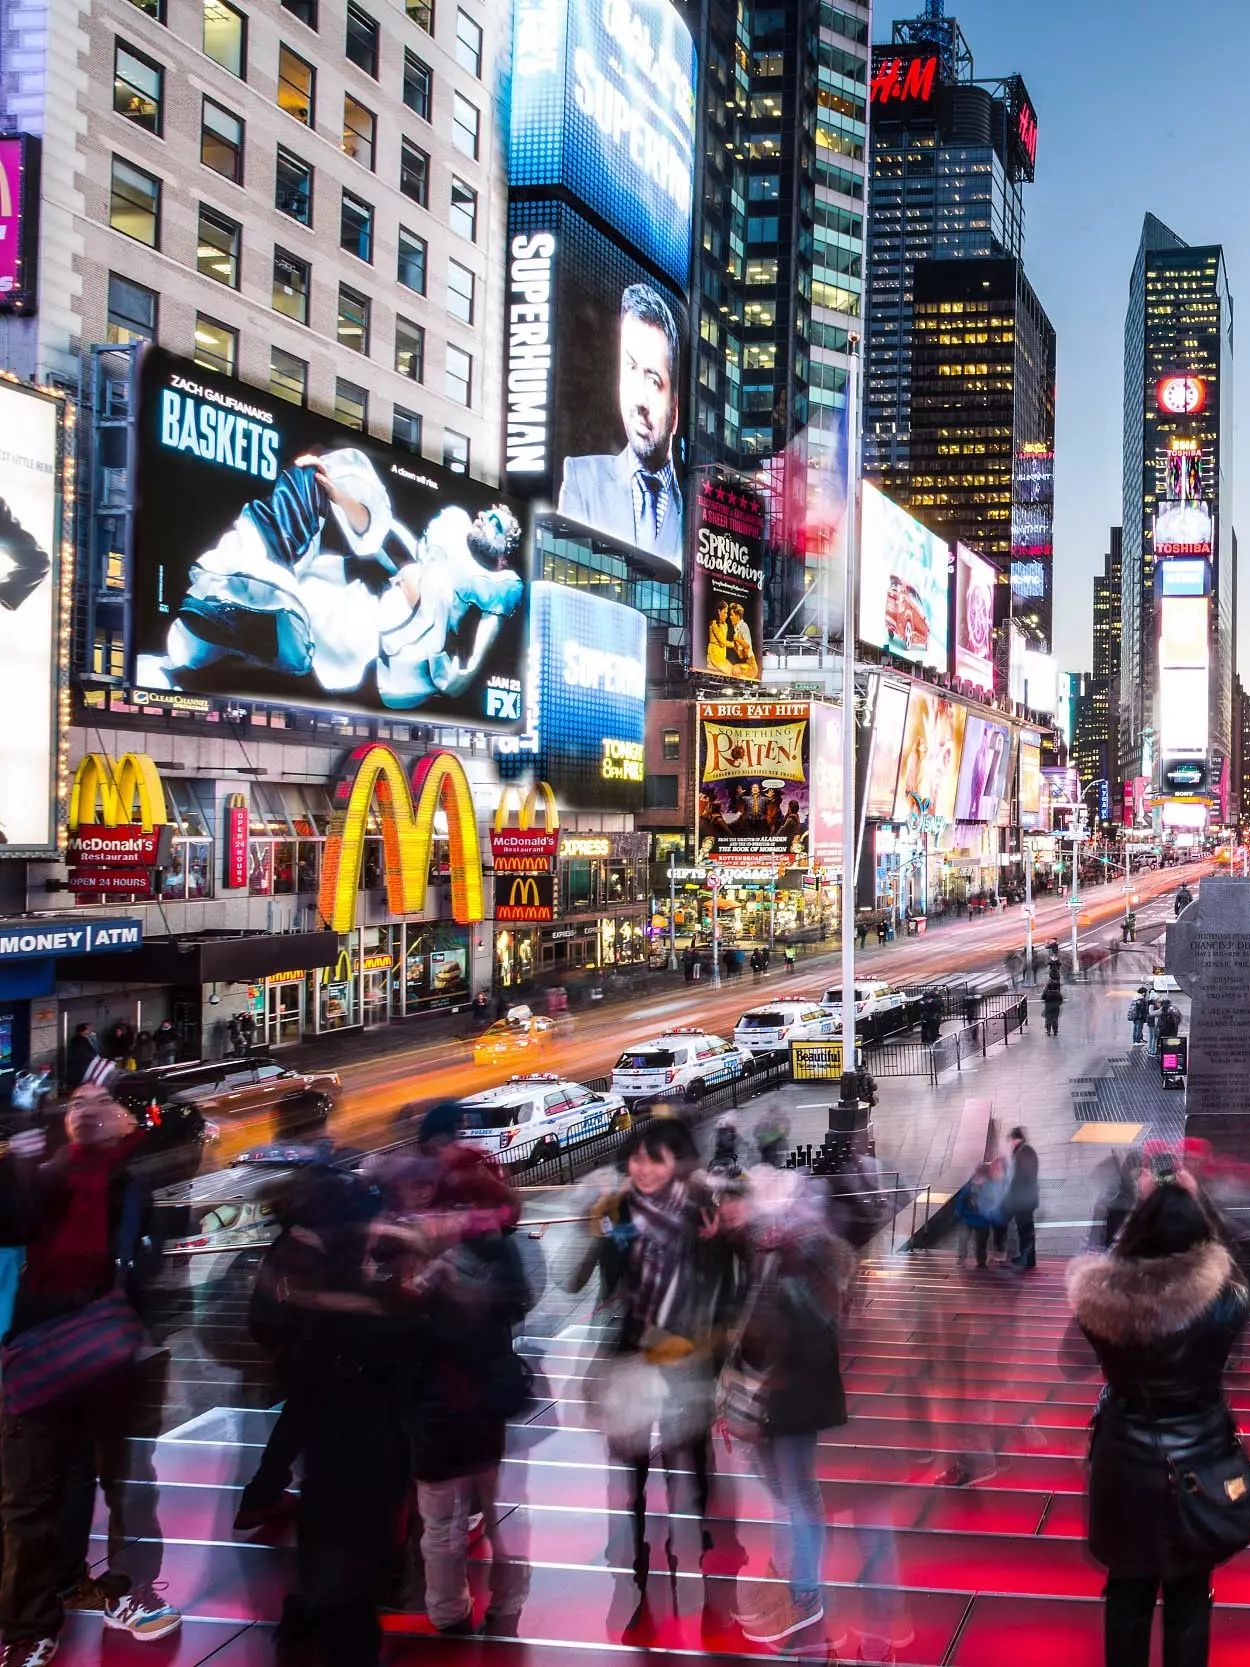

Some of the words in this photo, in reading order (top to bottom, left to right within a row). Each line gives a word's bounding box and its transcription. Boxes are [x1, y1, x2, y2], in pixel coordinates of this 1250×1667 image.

[506, 233, 555, 472] SUPERHUMAN
[169, 374, 203, 398] ZACH
[161, 388, 280, 482] BASKETS
[1167, 449, 1202, 457] TOSHIBA
[391, 464, 398, 474] A
[698, 528, 749, 564] SPRING
[1156, 543, 1211, 554] TOSHIBA
[696, 551, 765, 591] awakening
[487, 676, 510, 689] JAN
[486, 688, 517, 720] FX
[747, 704, 772, 716] FAT
[718, 728, 791, 738] SOMETHING
[236, 812, 244, 840] OPEN
[69, 837, 153, 852] McDonald's
[493, 837, 554, 846] McDonald's
[80, 852, 139, 862] Restaurant
[70, 877, 96, 887] OPEN
[99, 877, 110, 887] 24
[112, 877, 147, 888] HOURS
[0, 930, 83, 954] MONEY
[95, 927, 139, 946] ATM
[552, 930, 576, 939] EXPRESS
[797, 1047, 840, 1061] Beautiful
